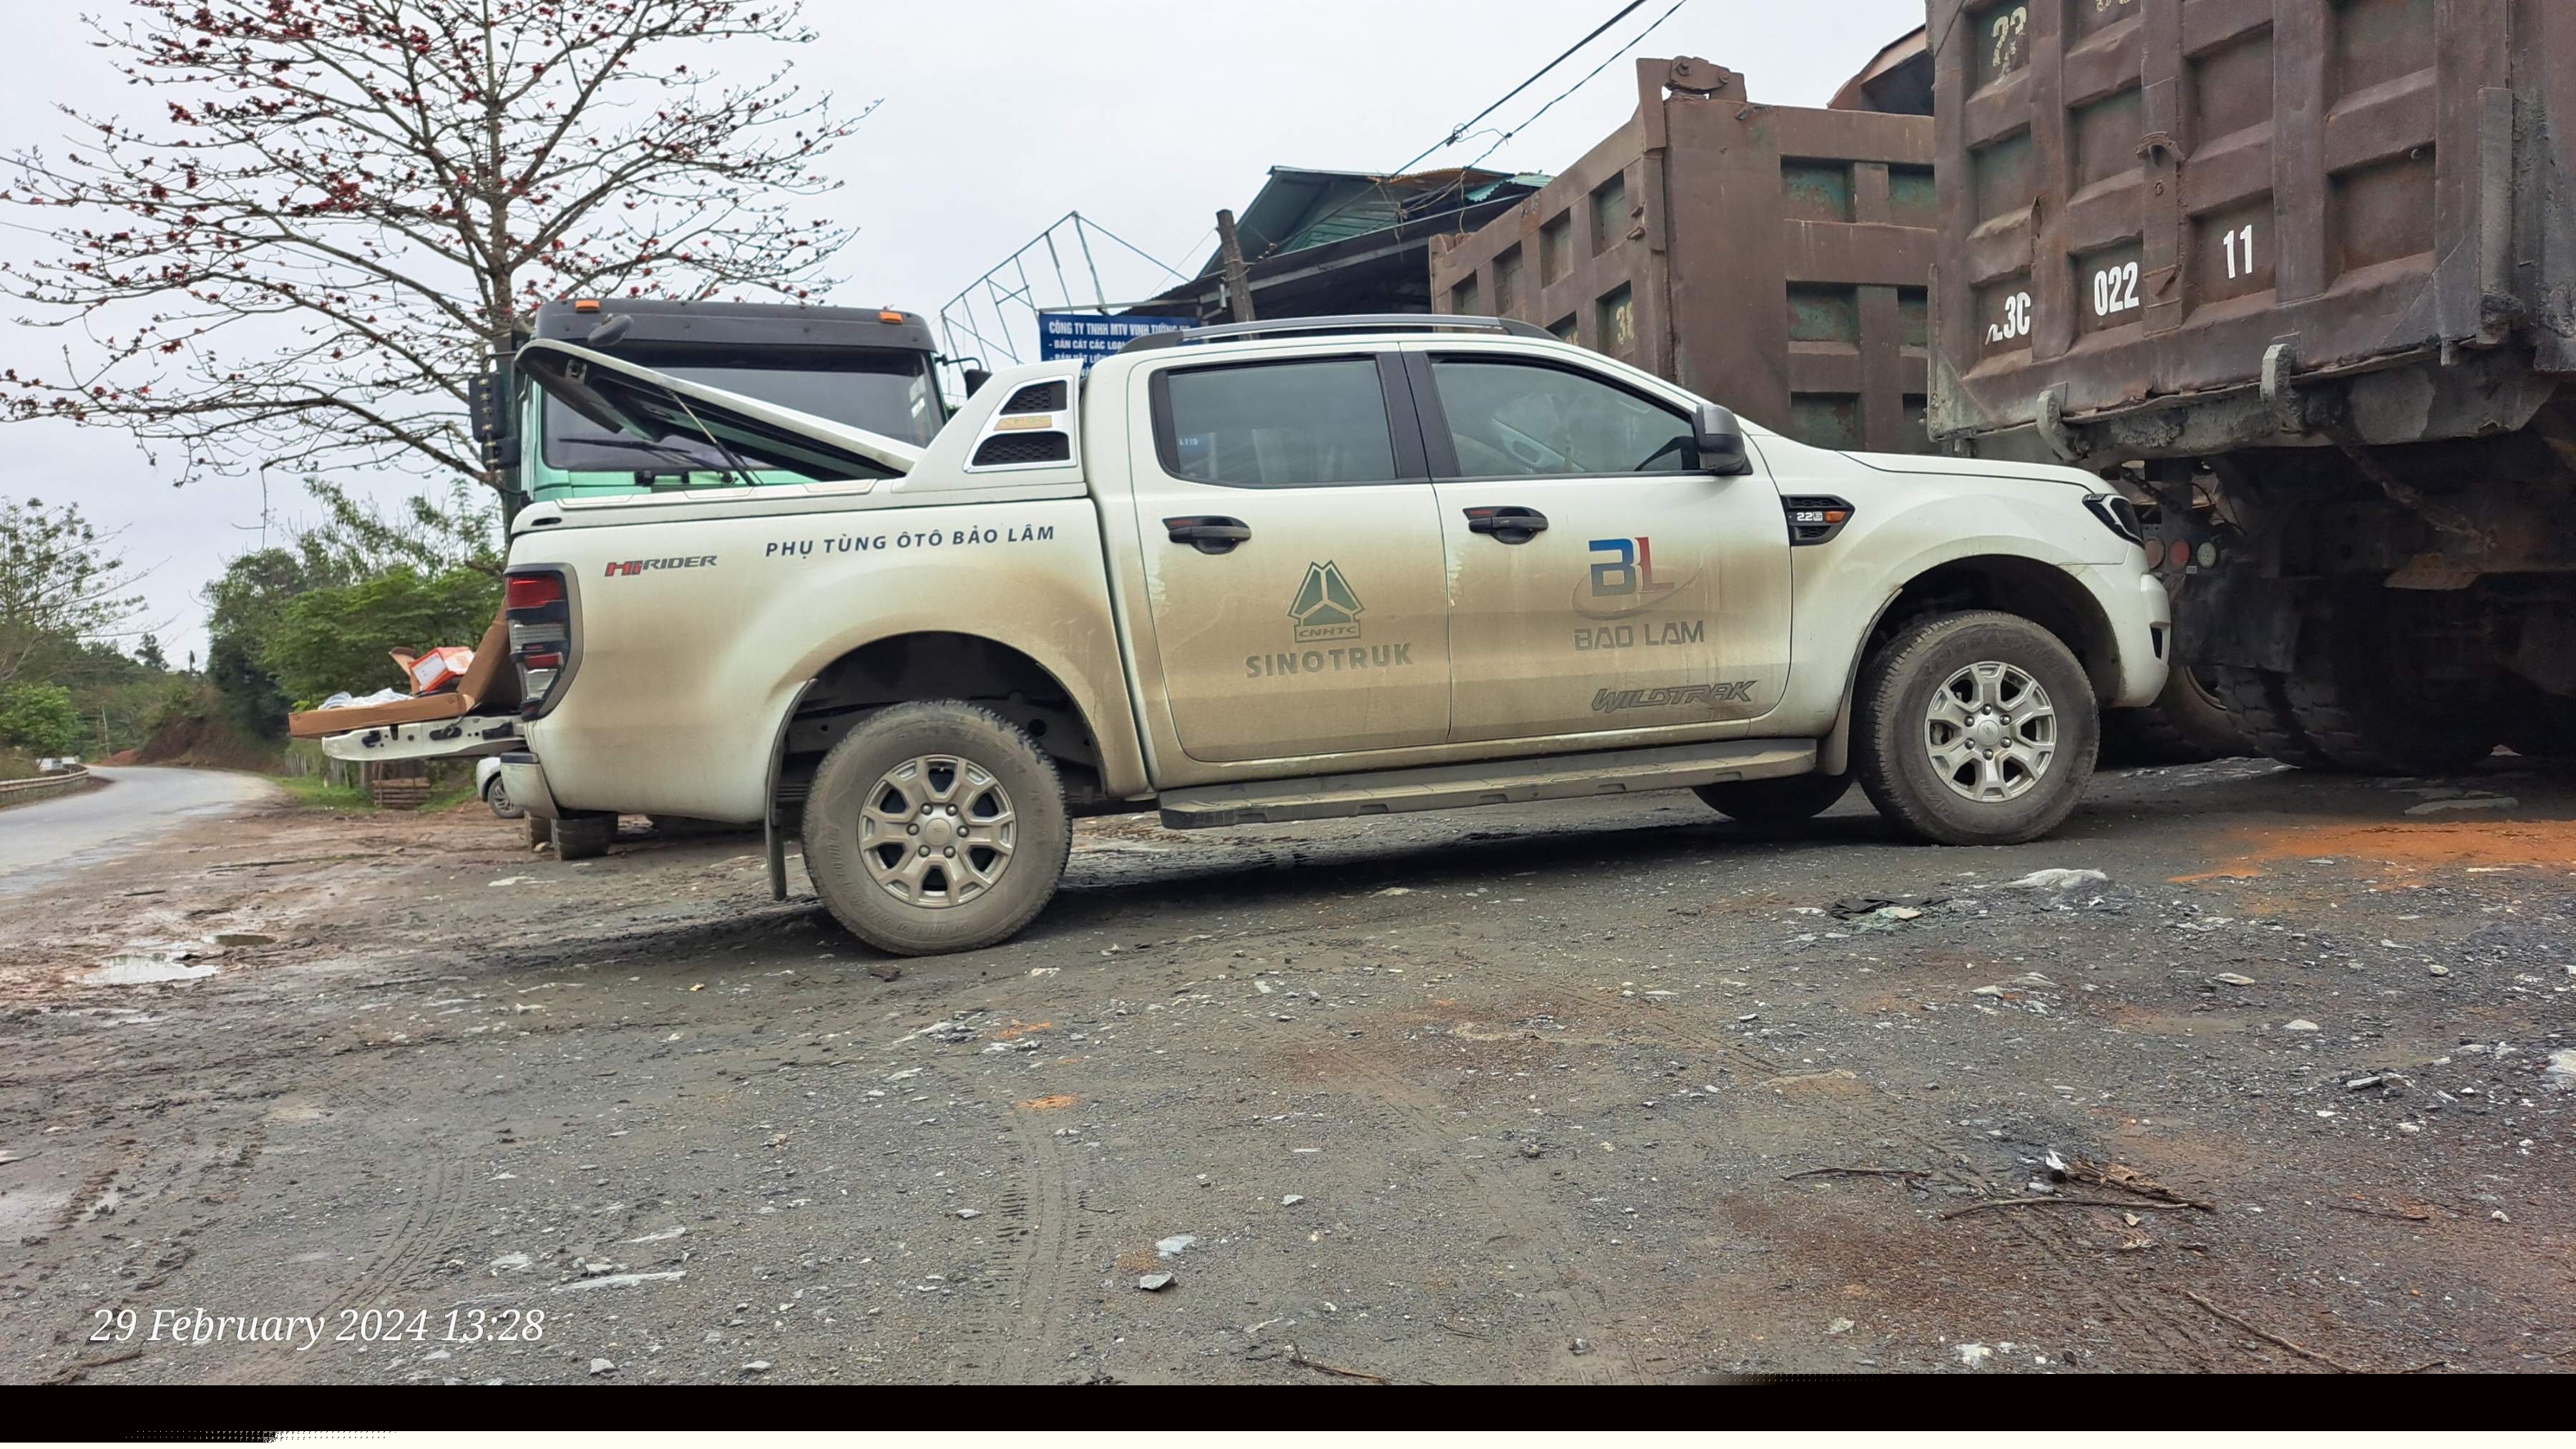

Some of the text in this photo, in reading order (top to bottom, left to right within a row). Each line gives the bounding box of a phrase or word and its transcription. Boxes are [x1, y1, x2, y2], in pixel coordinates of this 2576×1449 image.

[2094, 262, 2140, 316] 022
[2223, 224, 2253, 279] 11
[1049, 319, 1073, 335] CÔNG
[1074, 323, 1084, 335] TY
[1086, 323, 1108, 335] TNHH
[1111, 323, 1128, 336] MTV
[1054, 338, 1071, 349] BÁN
[1073, 338, 1088, 349] CÁT
[1089, 339, 1105, 350] CÁC
[766, 524, 1054, 560] PHỤ TÙNG ÔTÔ BẢO LÂM
[1299, 625, 1357, 637] CNHTC
[1574, 620, 1704, 651] BAO LAM
[1245, 642, 1413, 678] SINOTRUK
[1591, 680, 1758, 714] WILDTRAK
